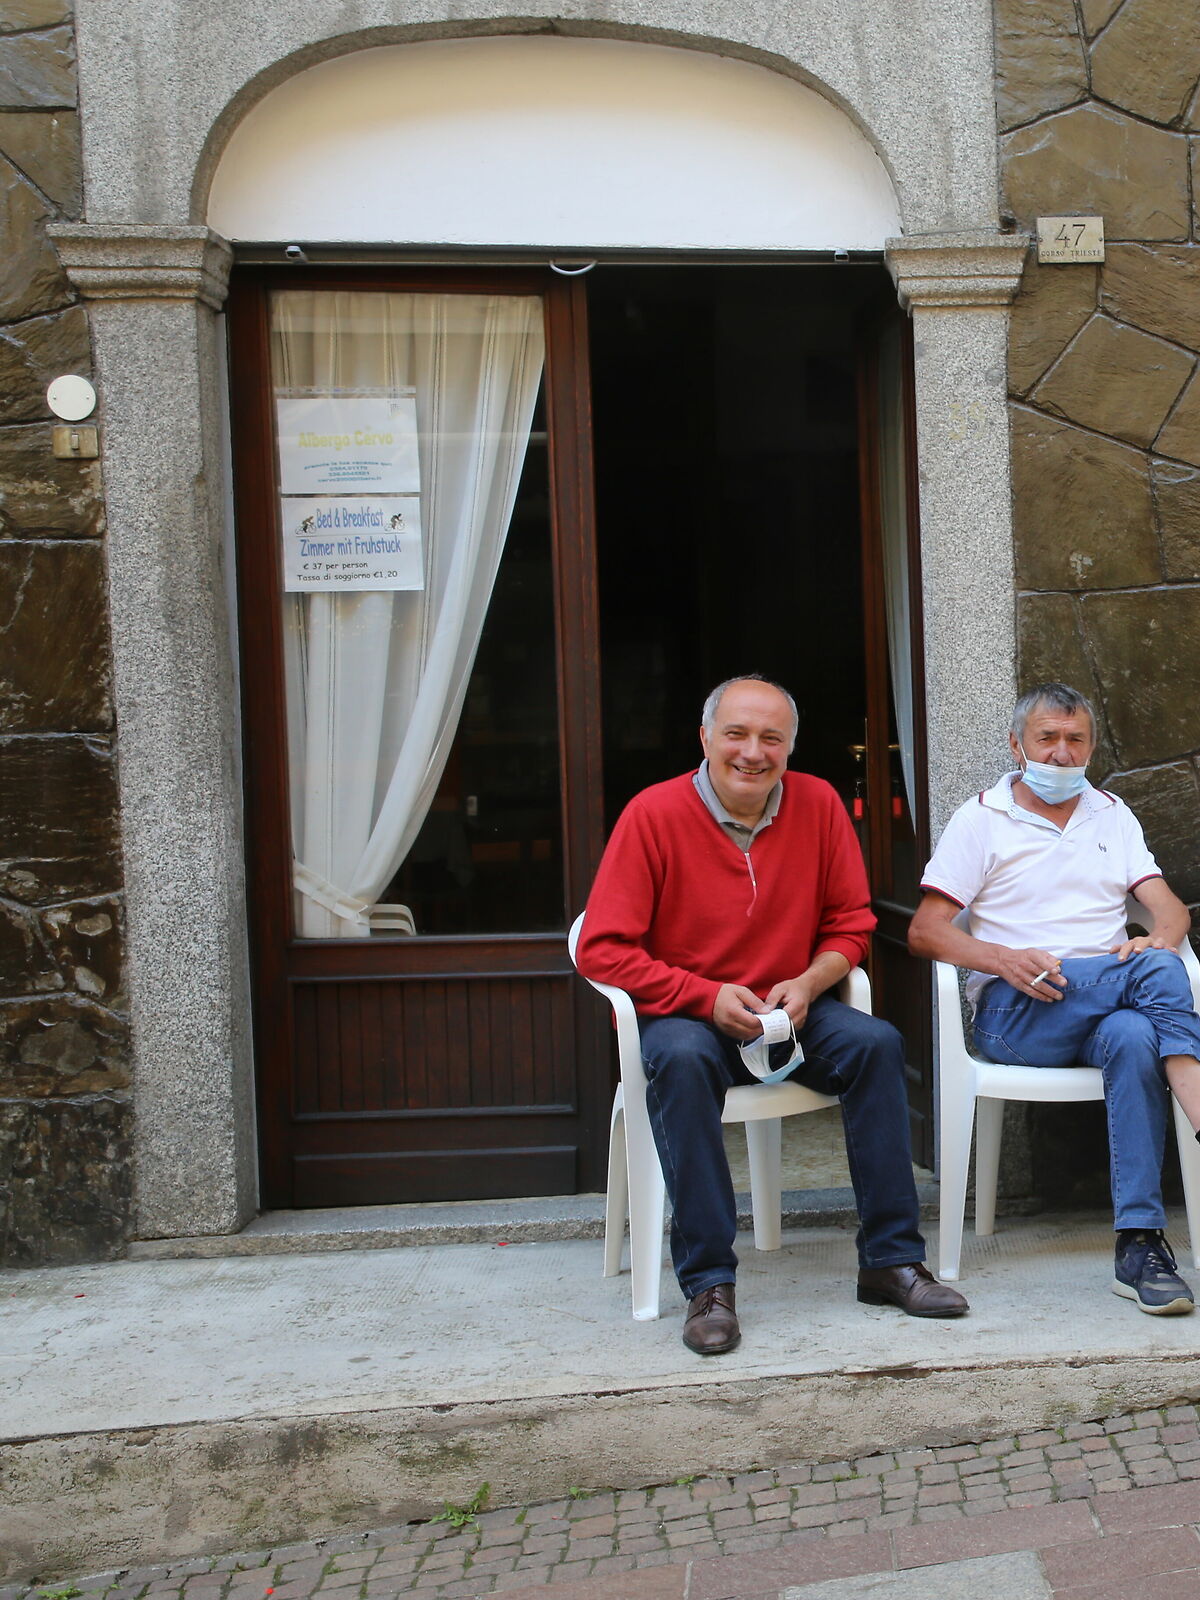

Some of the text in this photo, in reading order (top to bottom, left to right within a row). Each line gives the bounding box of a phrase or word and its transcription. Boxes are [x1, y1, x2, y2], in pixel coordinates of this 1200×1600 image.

[1055, 224, 1086, 248] 47
[1070, 249, 1101, 257] TRIESTE
[298, 431, 394, 451] Albergo Cervo
[317, 506, 384, 529] Bed & Breakfast
[300, 535, 402, 557] Zimmer mit Fruhstuck
[326, 563, 339, 571] per
[342, 562, 368, 571] person
[334, 572, 370, 582] soggiorno
